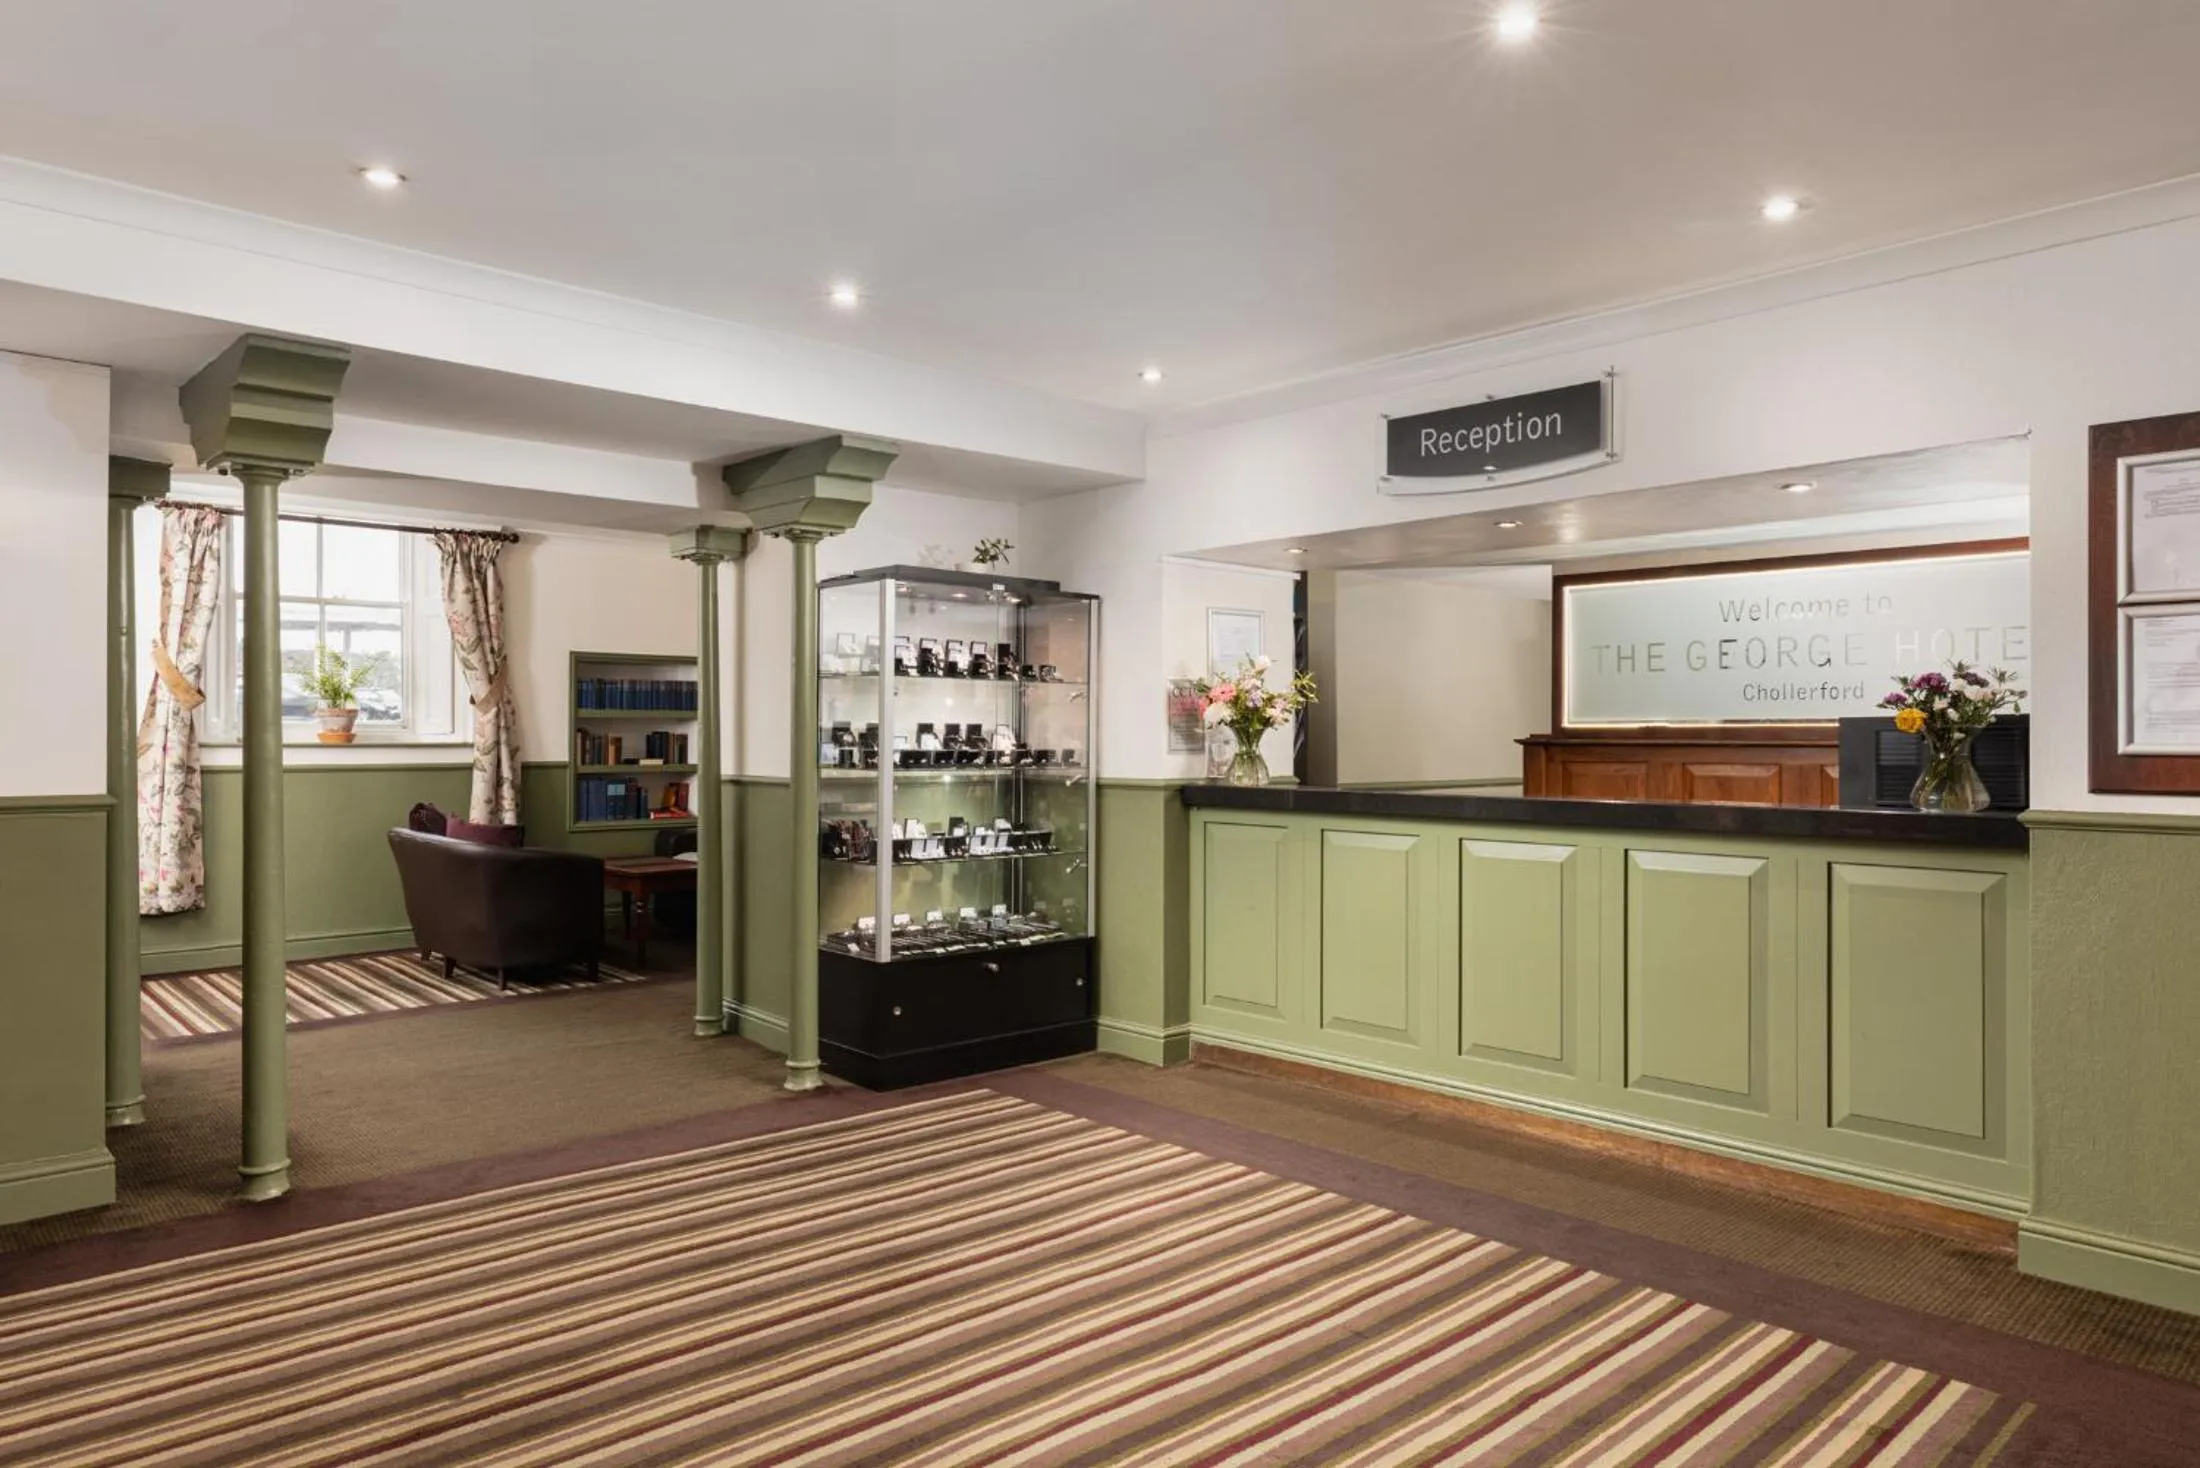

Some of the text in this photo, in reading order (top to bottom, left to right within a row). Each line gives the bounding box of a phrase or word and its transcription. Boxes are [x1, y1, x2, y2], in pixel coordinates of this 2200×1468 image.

[1420, 411, 1562, 457] Reception
[1718, 590, 1893, 623] Welcome to
[1591, 625, 2029, 674] THE GEORGE HOTE
[1743, 681, 1864, 702] Chollerford
